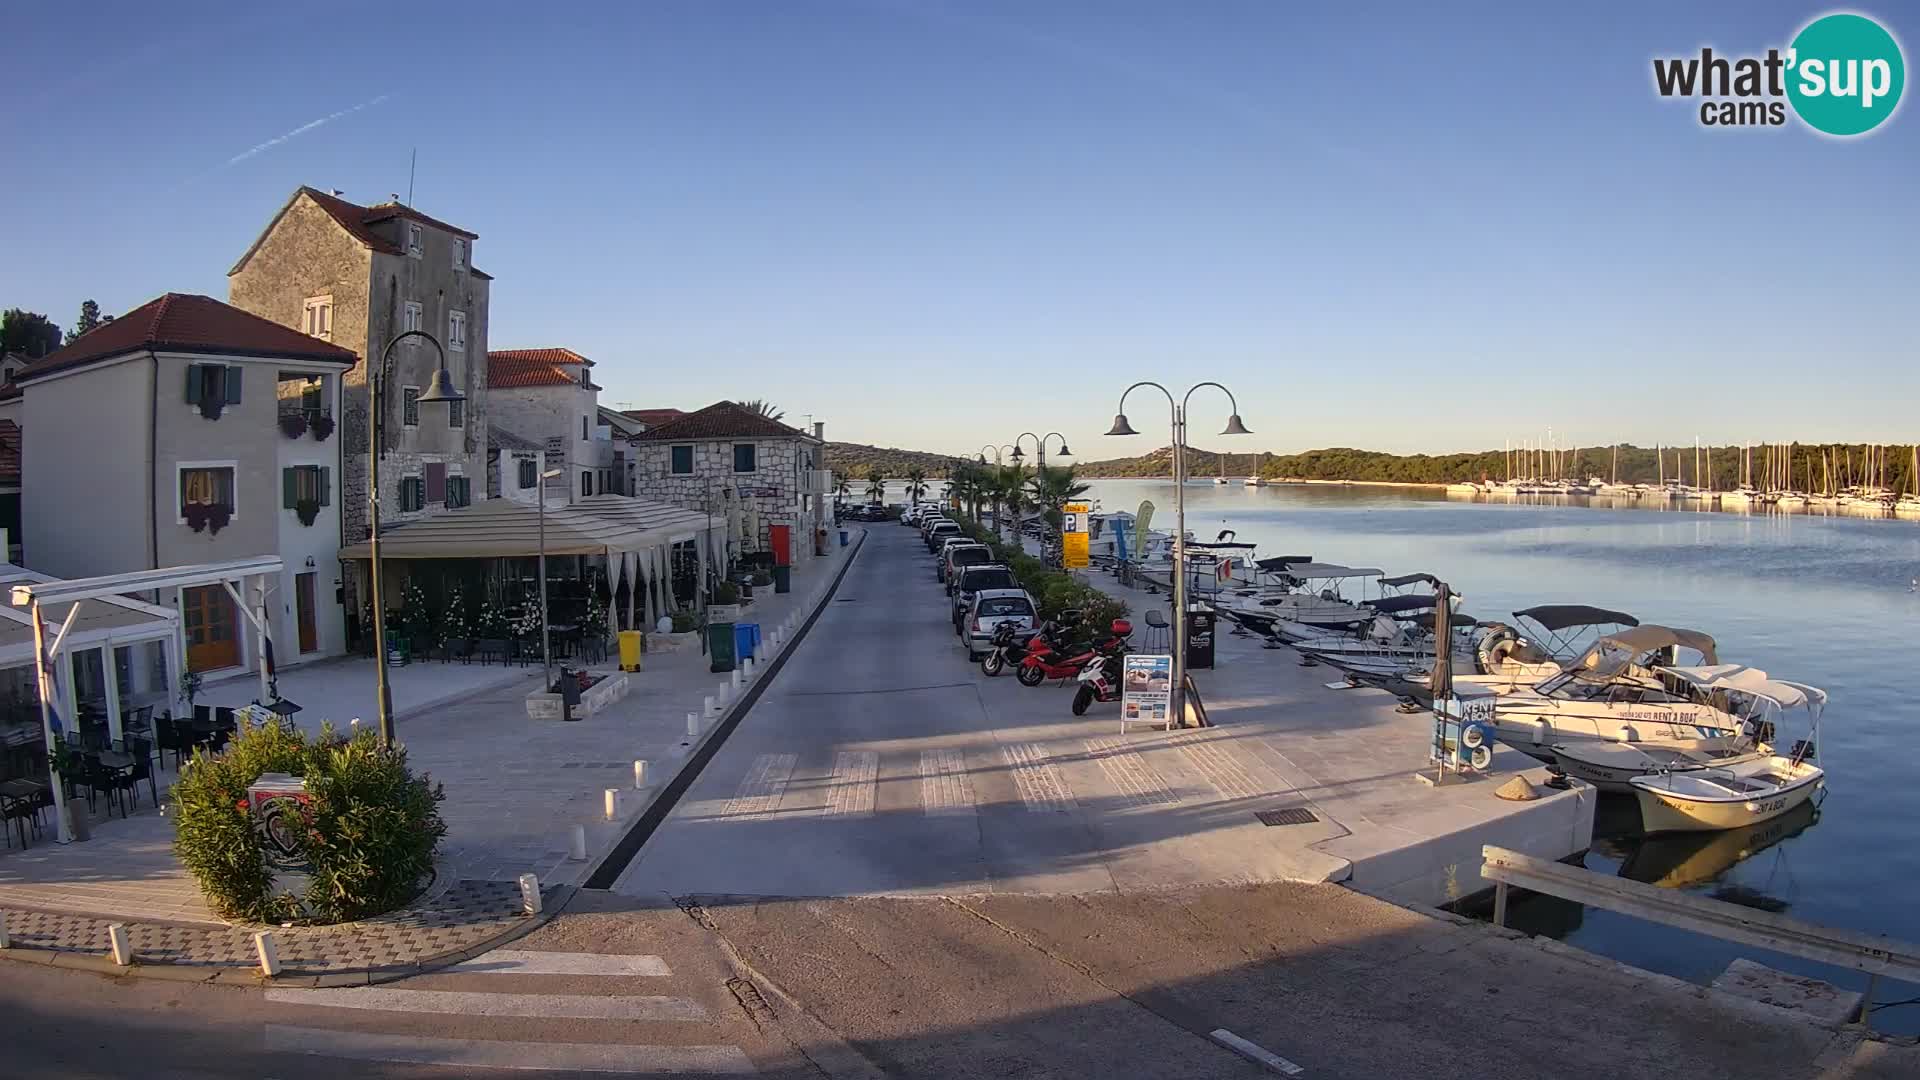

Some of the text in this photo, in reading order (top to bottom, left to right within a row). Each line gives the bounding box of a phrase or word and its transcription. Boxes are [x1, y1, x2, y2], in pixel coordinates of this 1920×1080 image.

[1065, 515, 1075, 531] P
[1463, 700, 1494, 713] RENT
[1471, 711, 1493, 720] BOAT
[1653, 712, 1672, 722] RENT
[1673, 712, 1678, 723] A
[1679, 712, 1698, 724] BOAT
